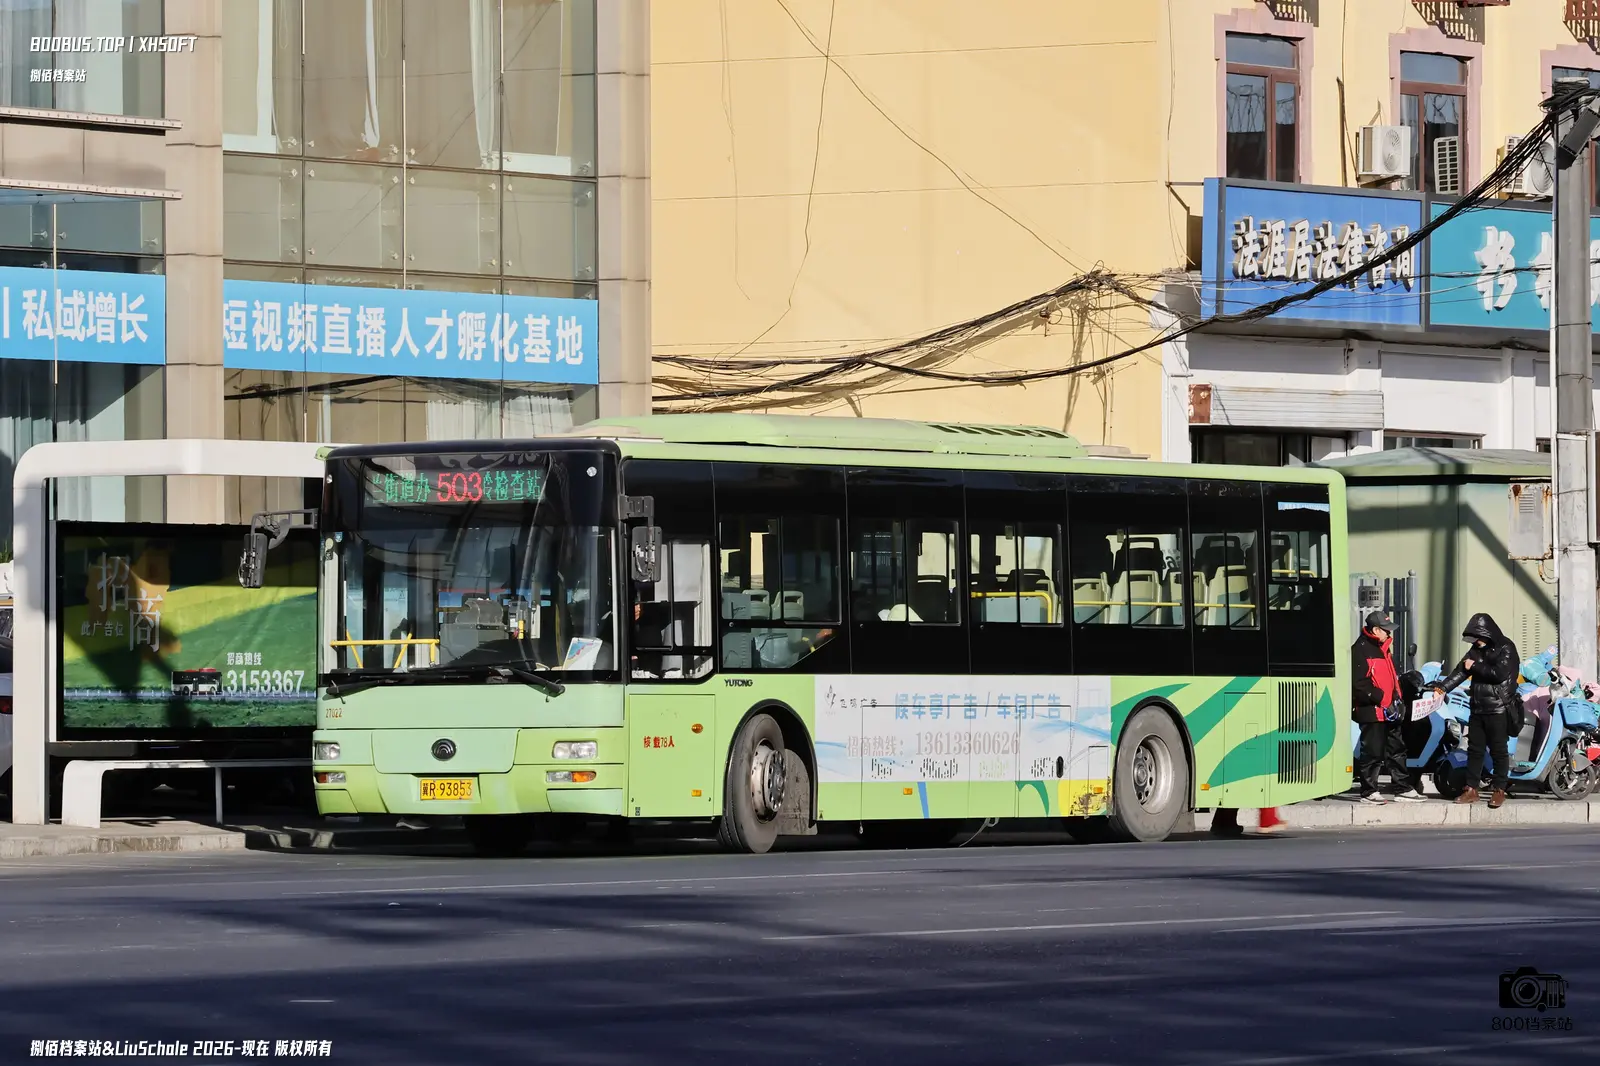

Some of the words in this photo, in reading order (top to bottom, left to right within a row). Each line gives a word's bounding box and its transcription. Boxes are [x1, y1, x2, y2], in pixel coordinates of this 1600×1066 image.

[1232, 216, 1416, 292] 法涯居法律咨询
[22, 288, 149, 344] 私域增长
[223, 299, 584, 365] 短视频直播人才孵化基地
[436, 472, 482, 502] 503
[81, 621, 124, 637] 此广告位
[226, 670, 305, 694] 3153367
[724, 679, 753, 687] YUTONG
[915, 731, 1020, 755] 13613360626
